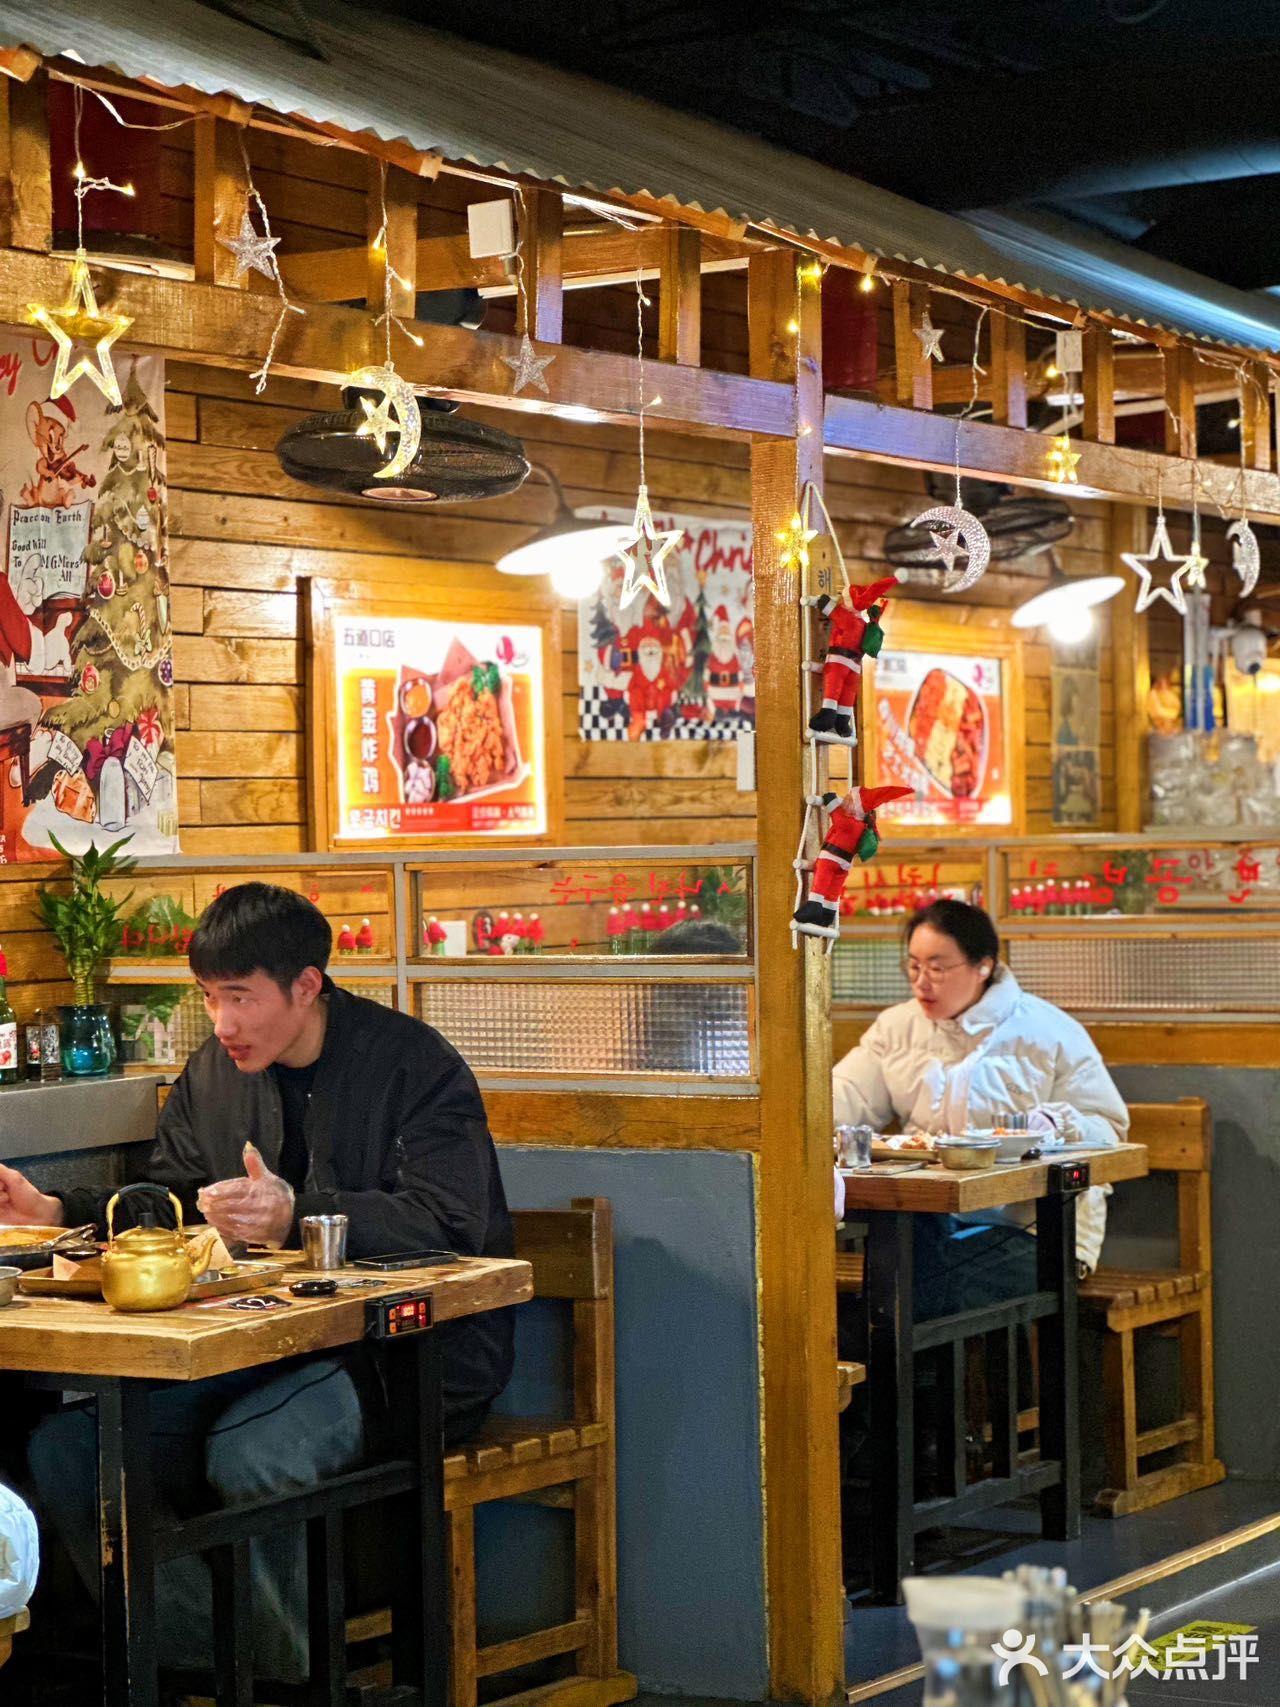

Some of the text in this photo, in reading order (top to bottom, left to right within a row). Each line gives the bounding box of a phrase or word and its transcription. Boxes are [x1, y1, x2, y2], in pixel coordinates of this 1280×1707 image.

[55, 509, 82, 525] Earth
[343, 627, 396, 648] 五道口店
